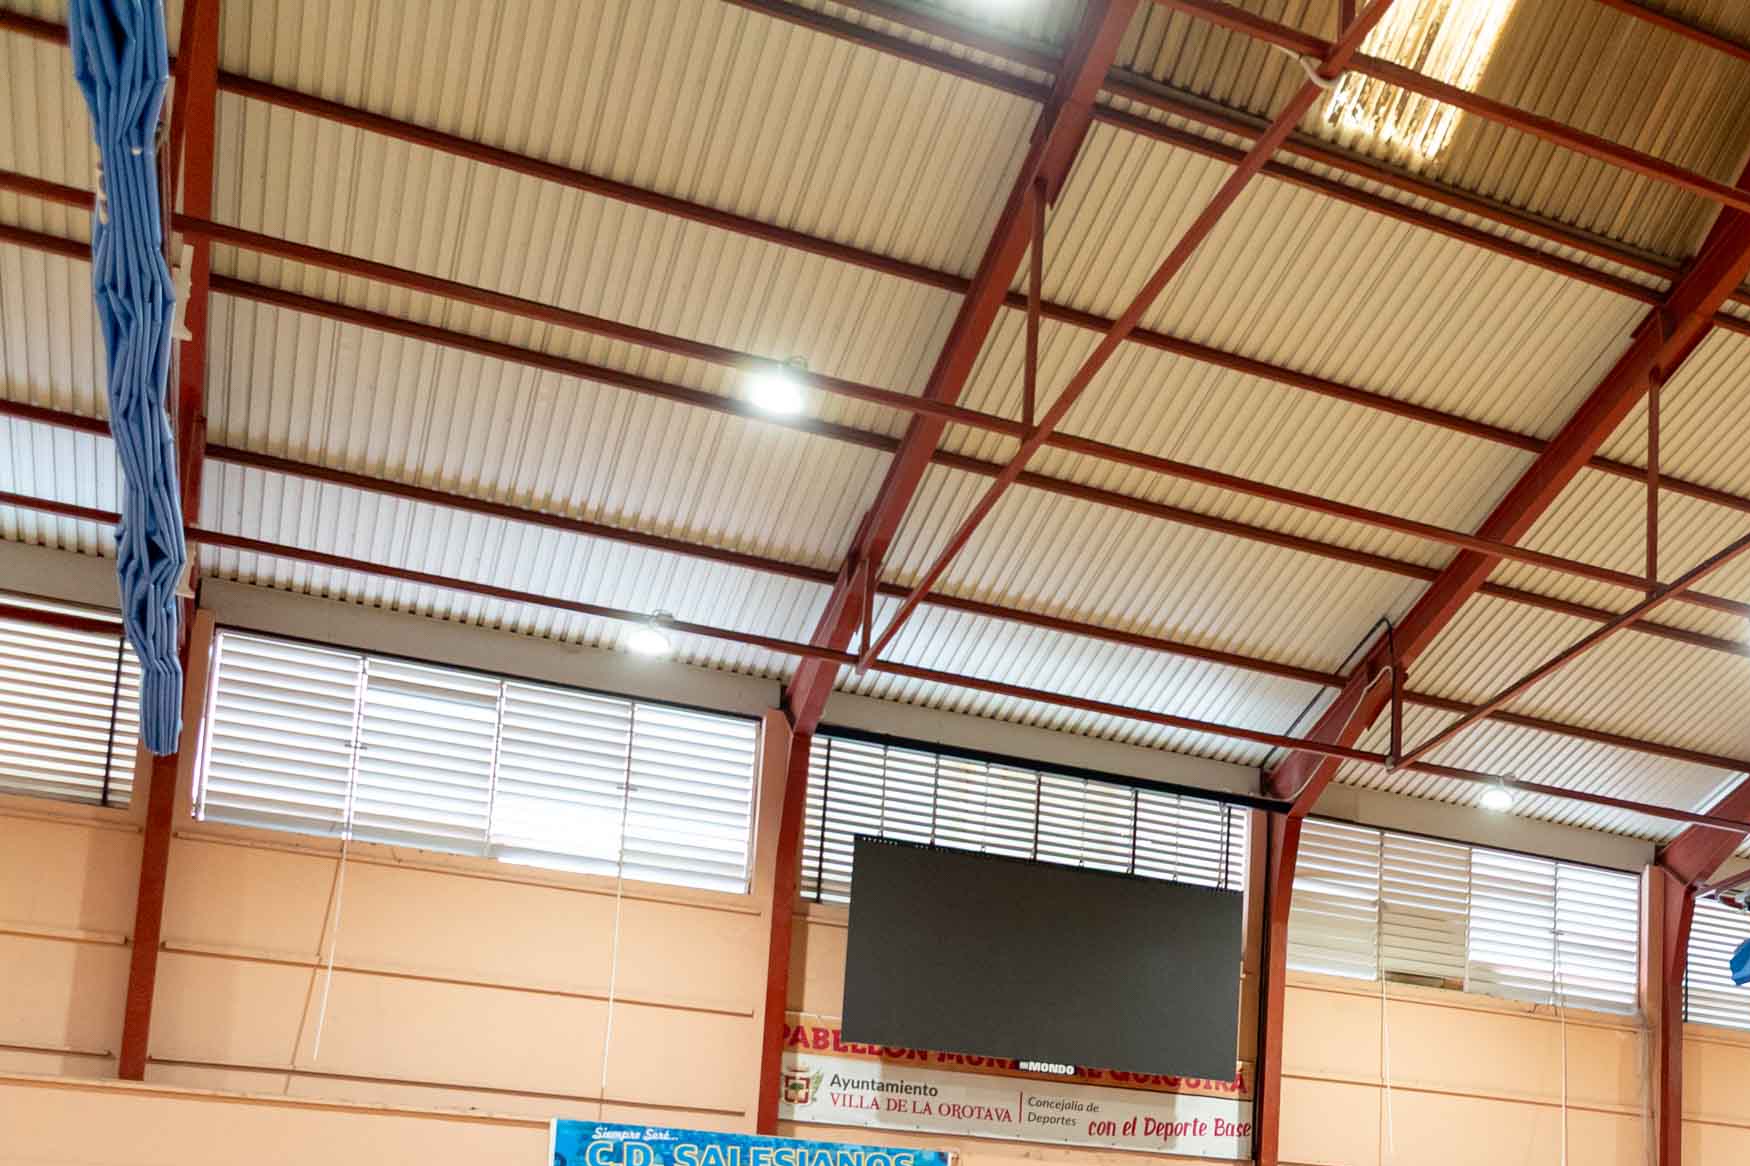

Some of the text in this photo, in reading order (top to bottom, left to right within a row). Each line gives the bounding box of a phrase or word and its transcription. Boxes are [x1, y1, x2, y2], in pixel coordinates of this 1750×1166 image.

[1028, 1062, 1075, 1075] MONDO
[830, 1074, 938, 1098] Ayuntamiento
[830, 1093, 1013, 1122] VILLA DE LA OROTAVA
[1086, 1102, 1099, 1112] de
[1027, 1112, 1076, 1127] Deportes
[1088, 1116, 1252, 1141] con el Deporte Base
